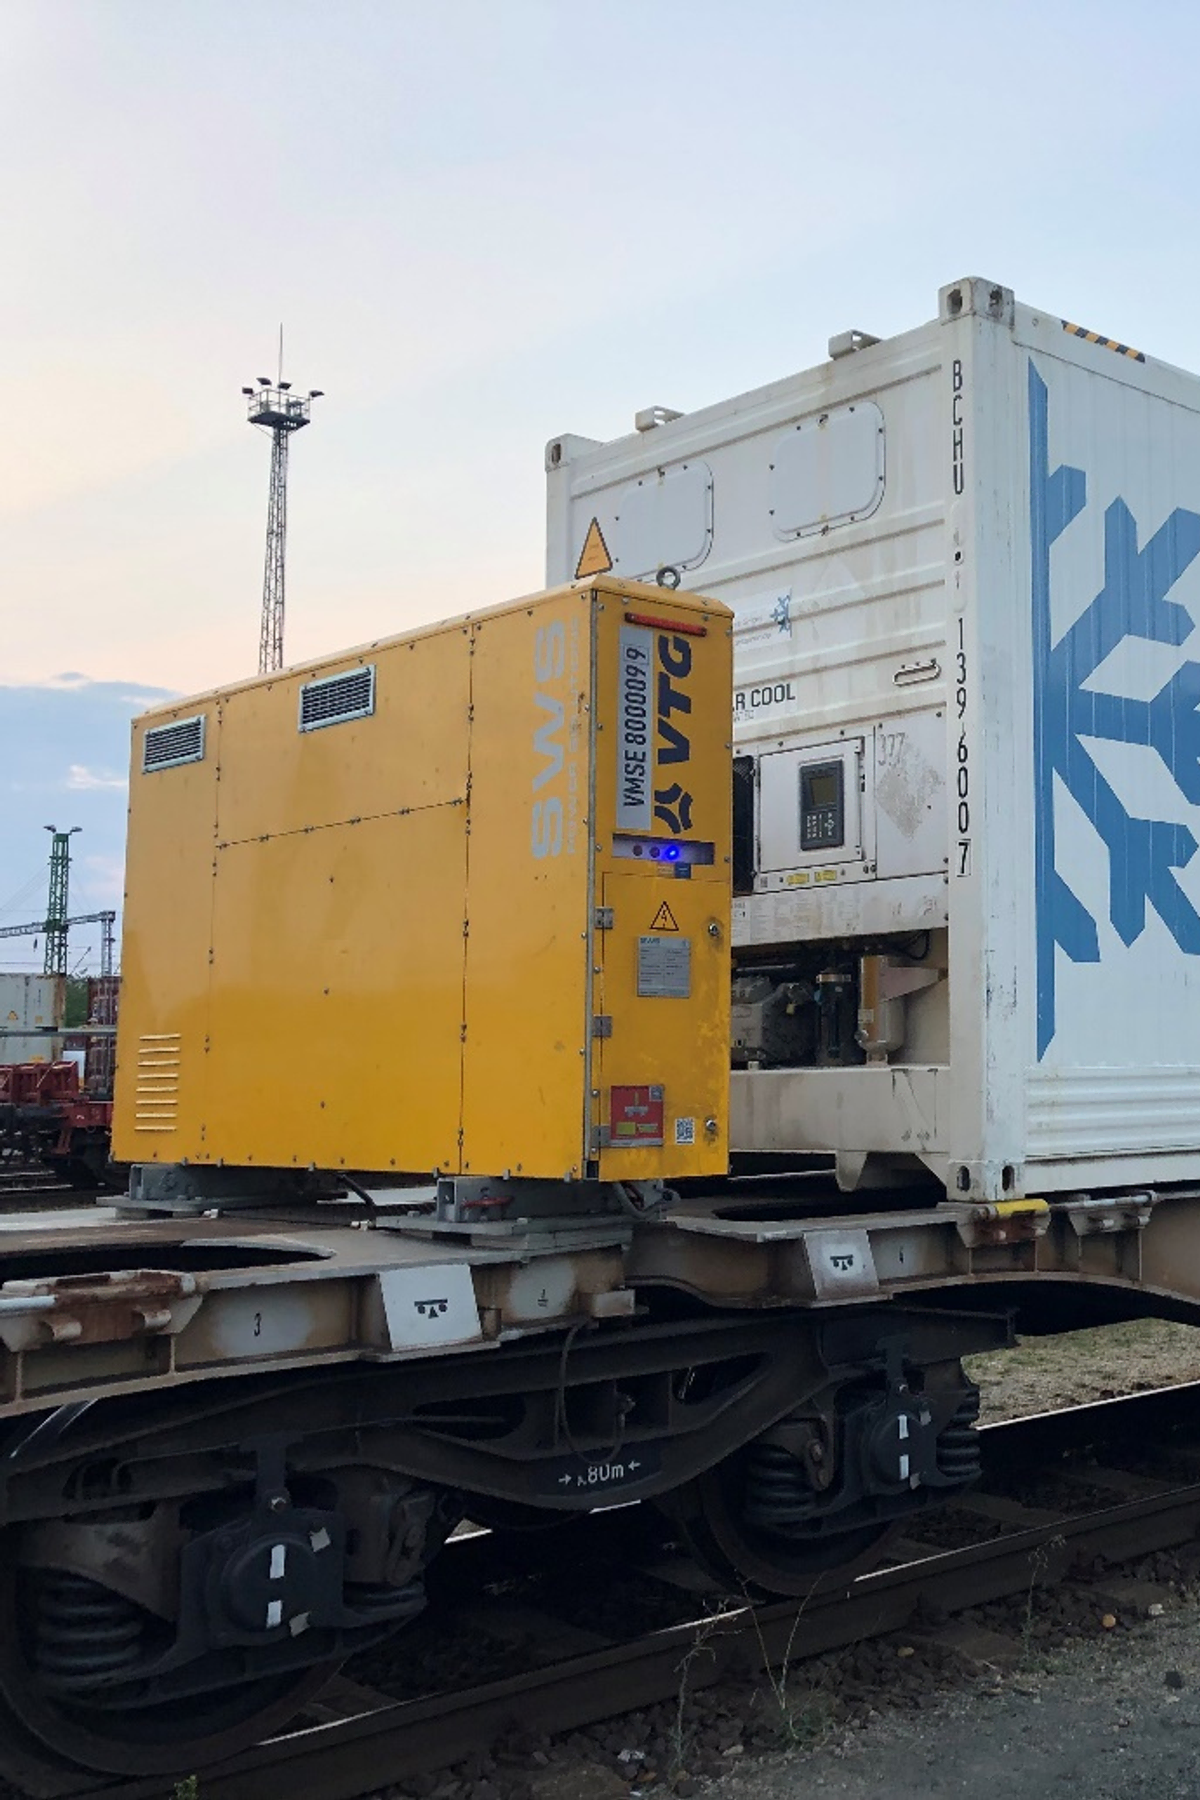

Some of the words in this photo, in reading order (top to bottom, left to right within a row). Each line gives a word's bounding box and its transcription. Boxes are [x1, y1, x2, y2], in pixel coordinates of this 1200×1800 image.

[953, 359, 964, 495] BCHU
[531, 618, 565, 860] SWS
[624, 646, 647, 746] 8000099
[657, 634, 692, 766] VTG
[751, 682, 796, 708] COOL
[623, 751, 647, 808] VMSE
